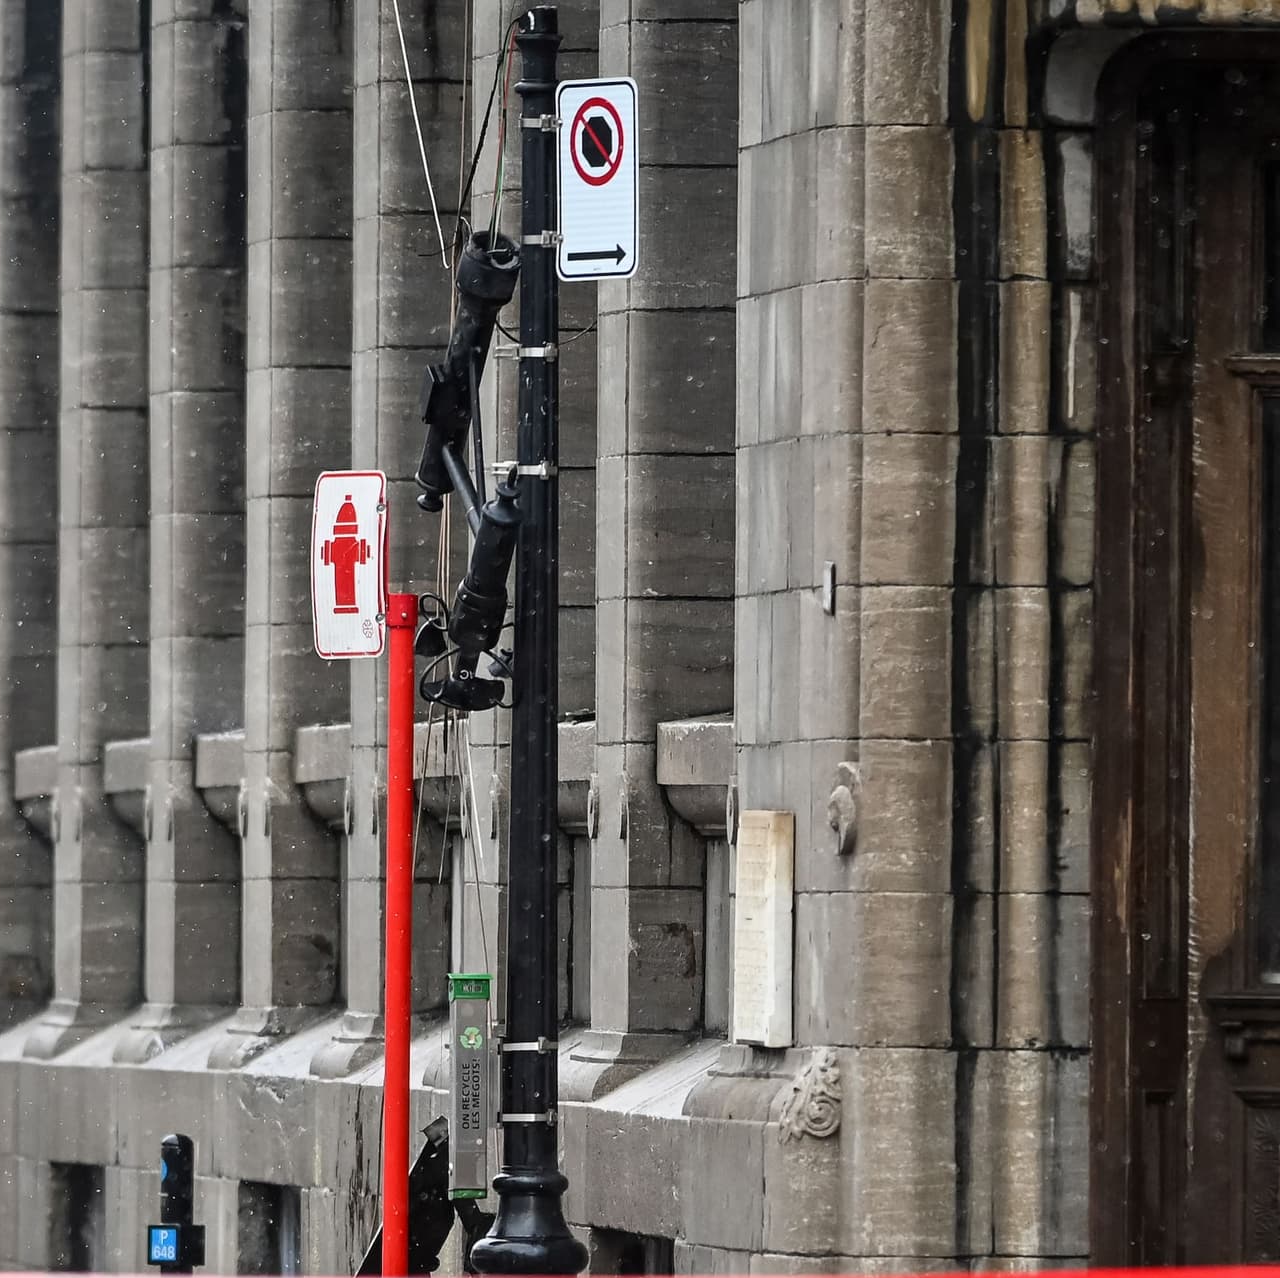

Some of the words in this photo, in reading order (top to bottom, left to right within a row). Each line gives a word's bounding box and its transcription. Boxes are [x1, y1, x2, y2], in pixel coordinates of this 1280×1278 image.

[462, 1063, 470, 1111] RECYCLE
[471, 1058, 480, 1109] MÉGOTS!
[462, 1113, 470, 1130] ON
[472, 1111, 480, 1130] LES
[160, 1230, 169, 1245] P
[154, 1245, 175, 1259] 648
